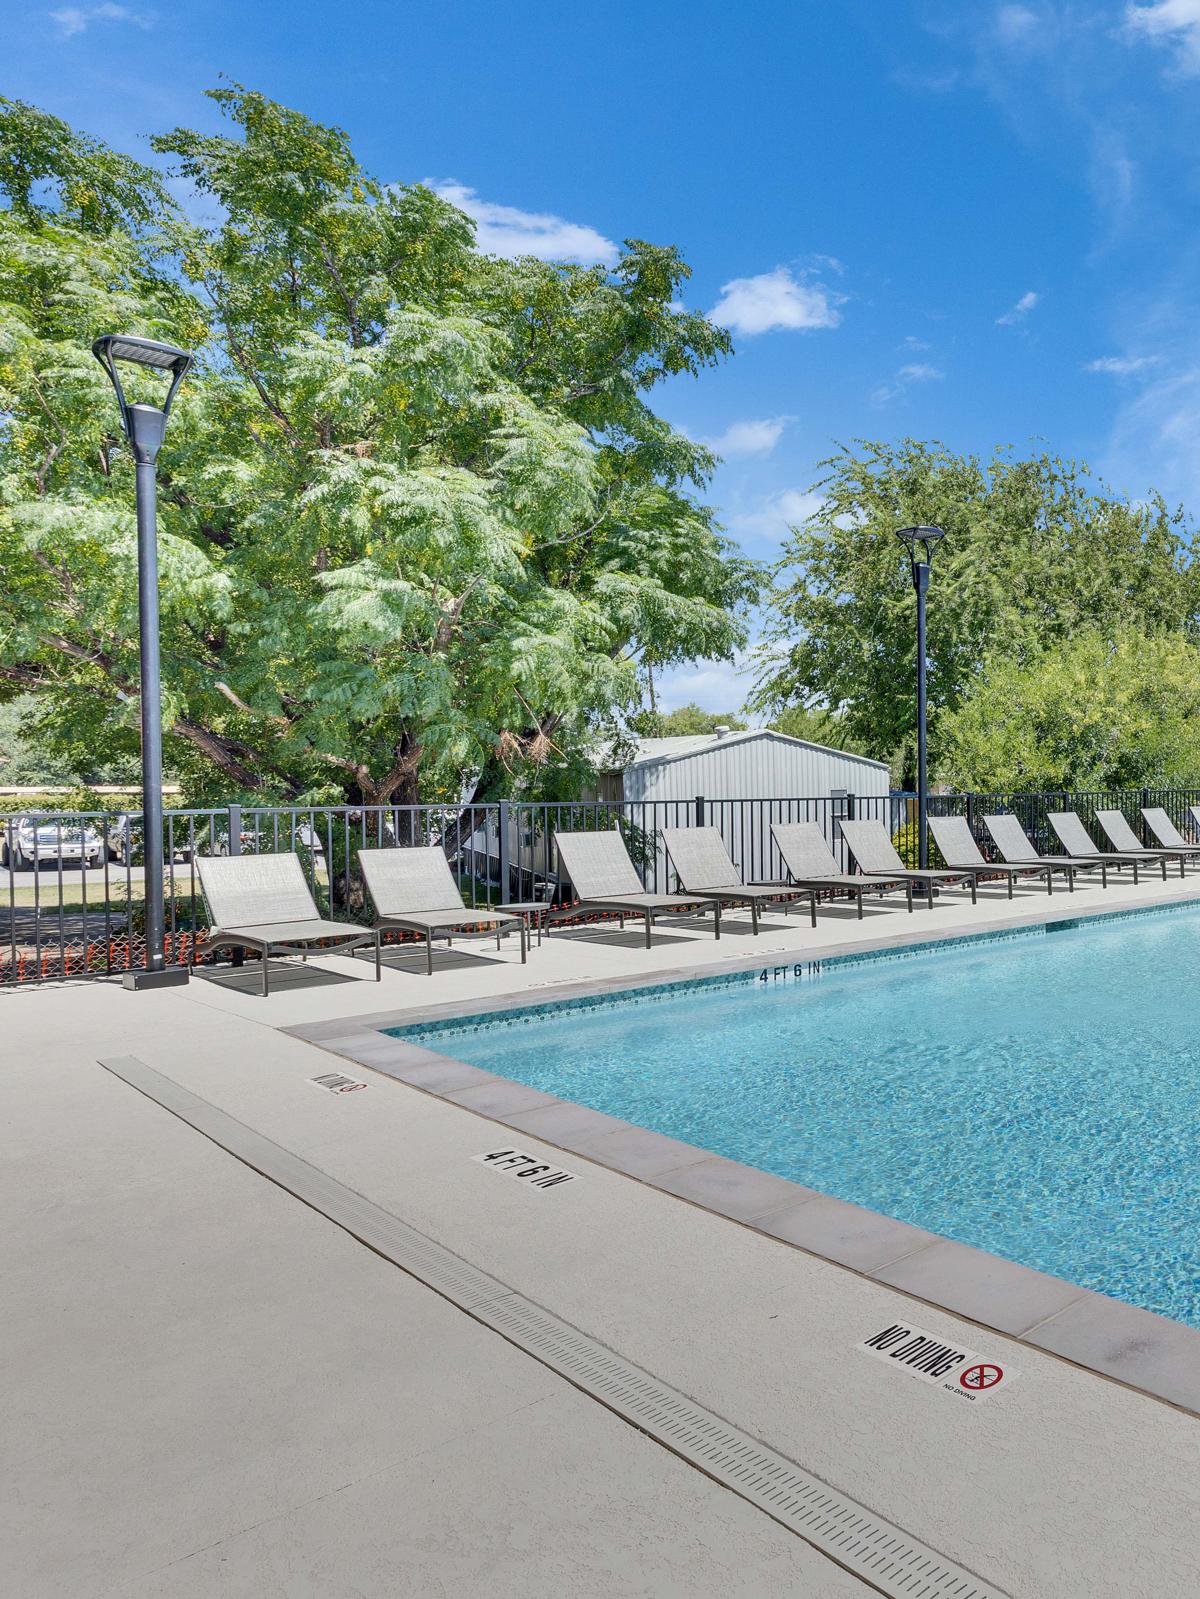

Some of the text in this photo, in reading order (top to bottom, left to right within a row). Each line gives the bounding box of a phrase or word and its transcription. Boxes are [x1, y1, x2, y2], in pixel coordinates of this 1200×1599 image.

[759, 961, 820, 982] 4 FT 6 IN
[483, 1150, 574, 1188] 4 FT 6 IN
[864, 1324, 966, 1378] NO DIVING
[943, 1383, 977, 1401] NO DIVING
